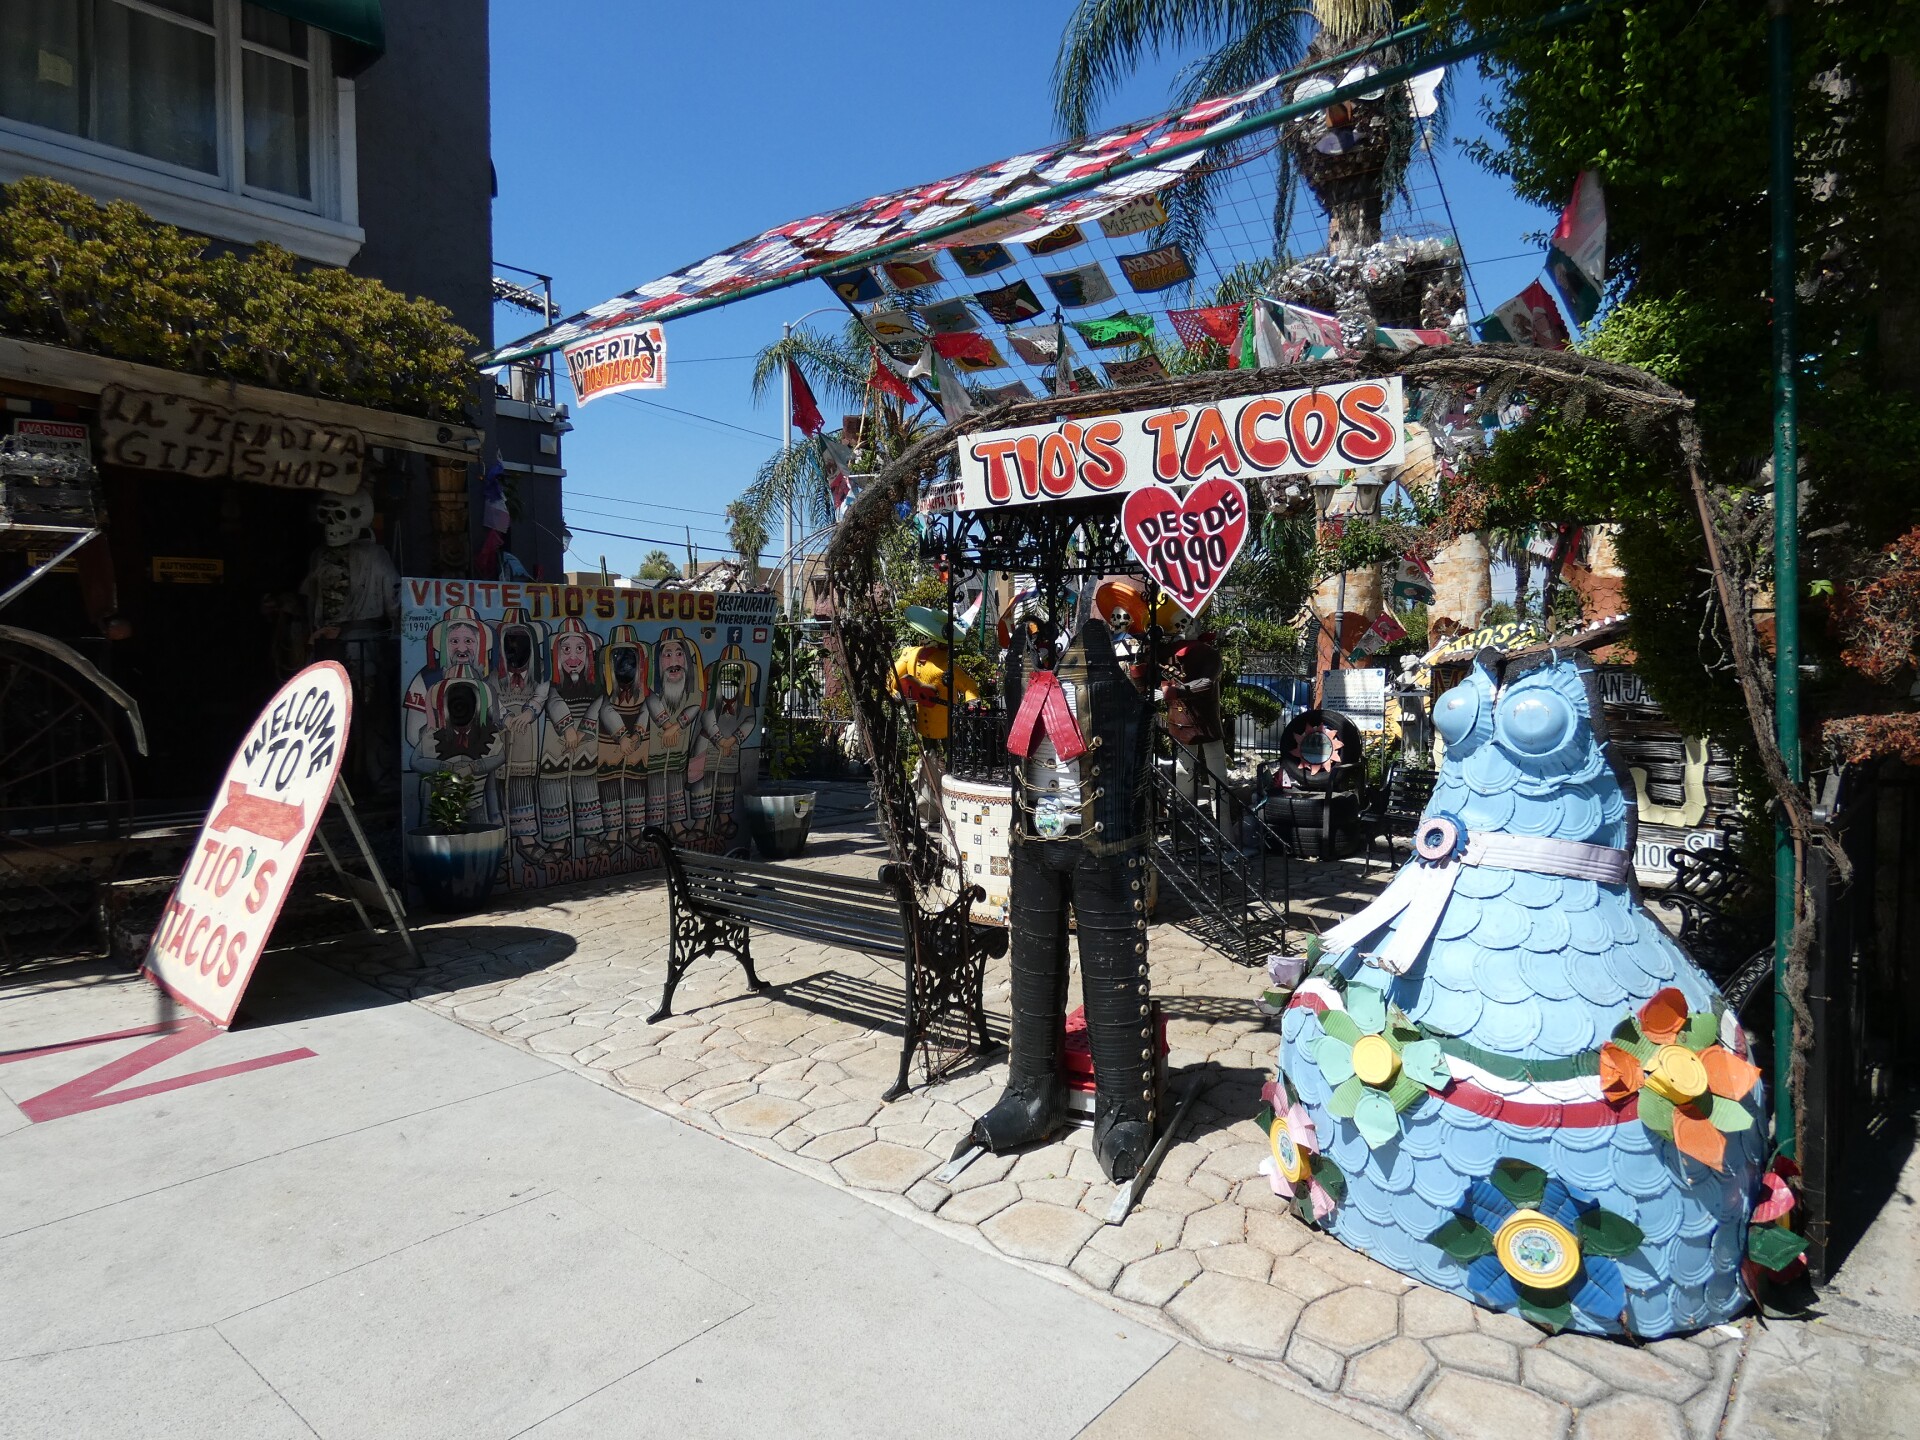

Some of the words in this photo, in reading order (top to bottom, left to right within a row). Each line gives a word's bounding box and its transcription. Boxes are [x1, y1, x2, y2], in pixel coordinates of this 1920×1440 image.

[1122, 246, 1180, 273] NANY
[568, 331, 662, 396] LOTERIA
[605, 356, 653, 385] TACOS
[22, 423, 84, 438] WARNING
[116, 430, 224, 474] GIFT
[972, 420, 1128, 504] TIO'S
[1143, 384, 1397, 483] TACOS
[1137, 492, 1244, 547] DESDE
[1148, 532, 1227, 604] 1990
[411, 579, 522, 608] VISITE
[525, 585, 615, 619] TIO'S
[620, 589, 715, 621] TACOS
[715, 594, 778, 614] RESTAURANT
[408, 622, 430, 632] 1990
[244, 686, 336, 779] WELCOME
[258, 737, 305, 792] TO
[193, 838, 278, 915] TIO'S
[509, 863, 539, 891] LA
[545, 853, 611, 885] DANZA
[159, 900, 248, 988] TACOS
